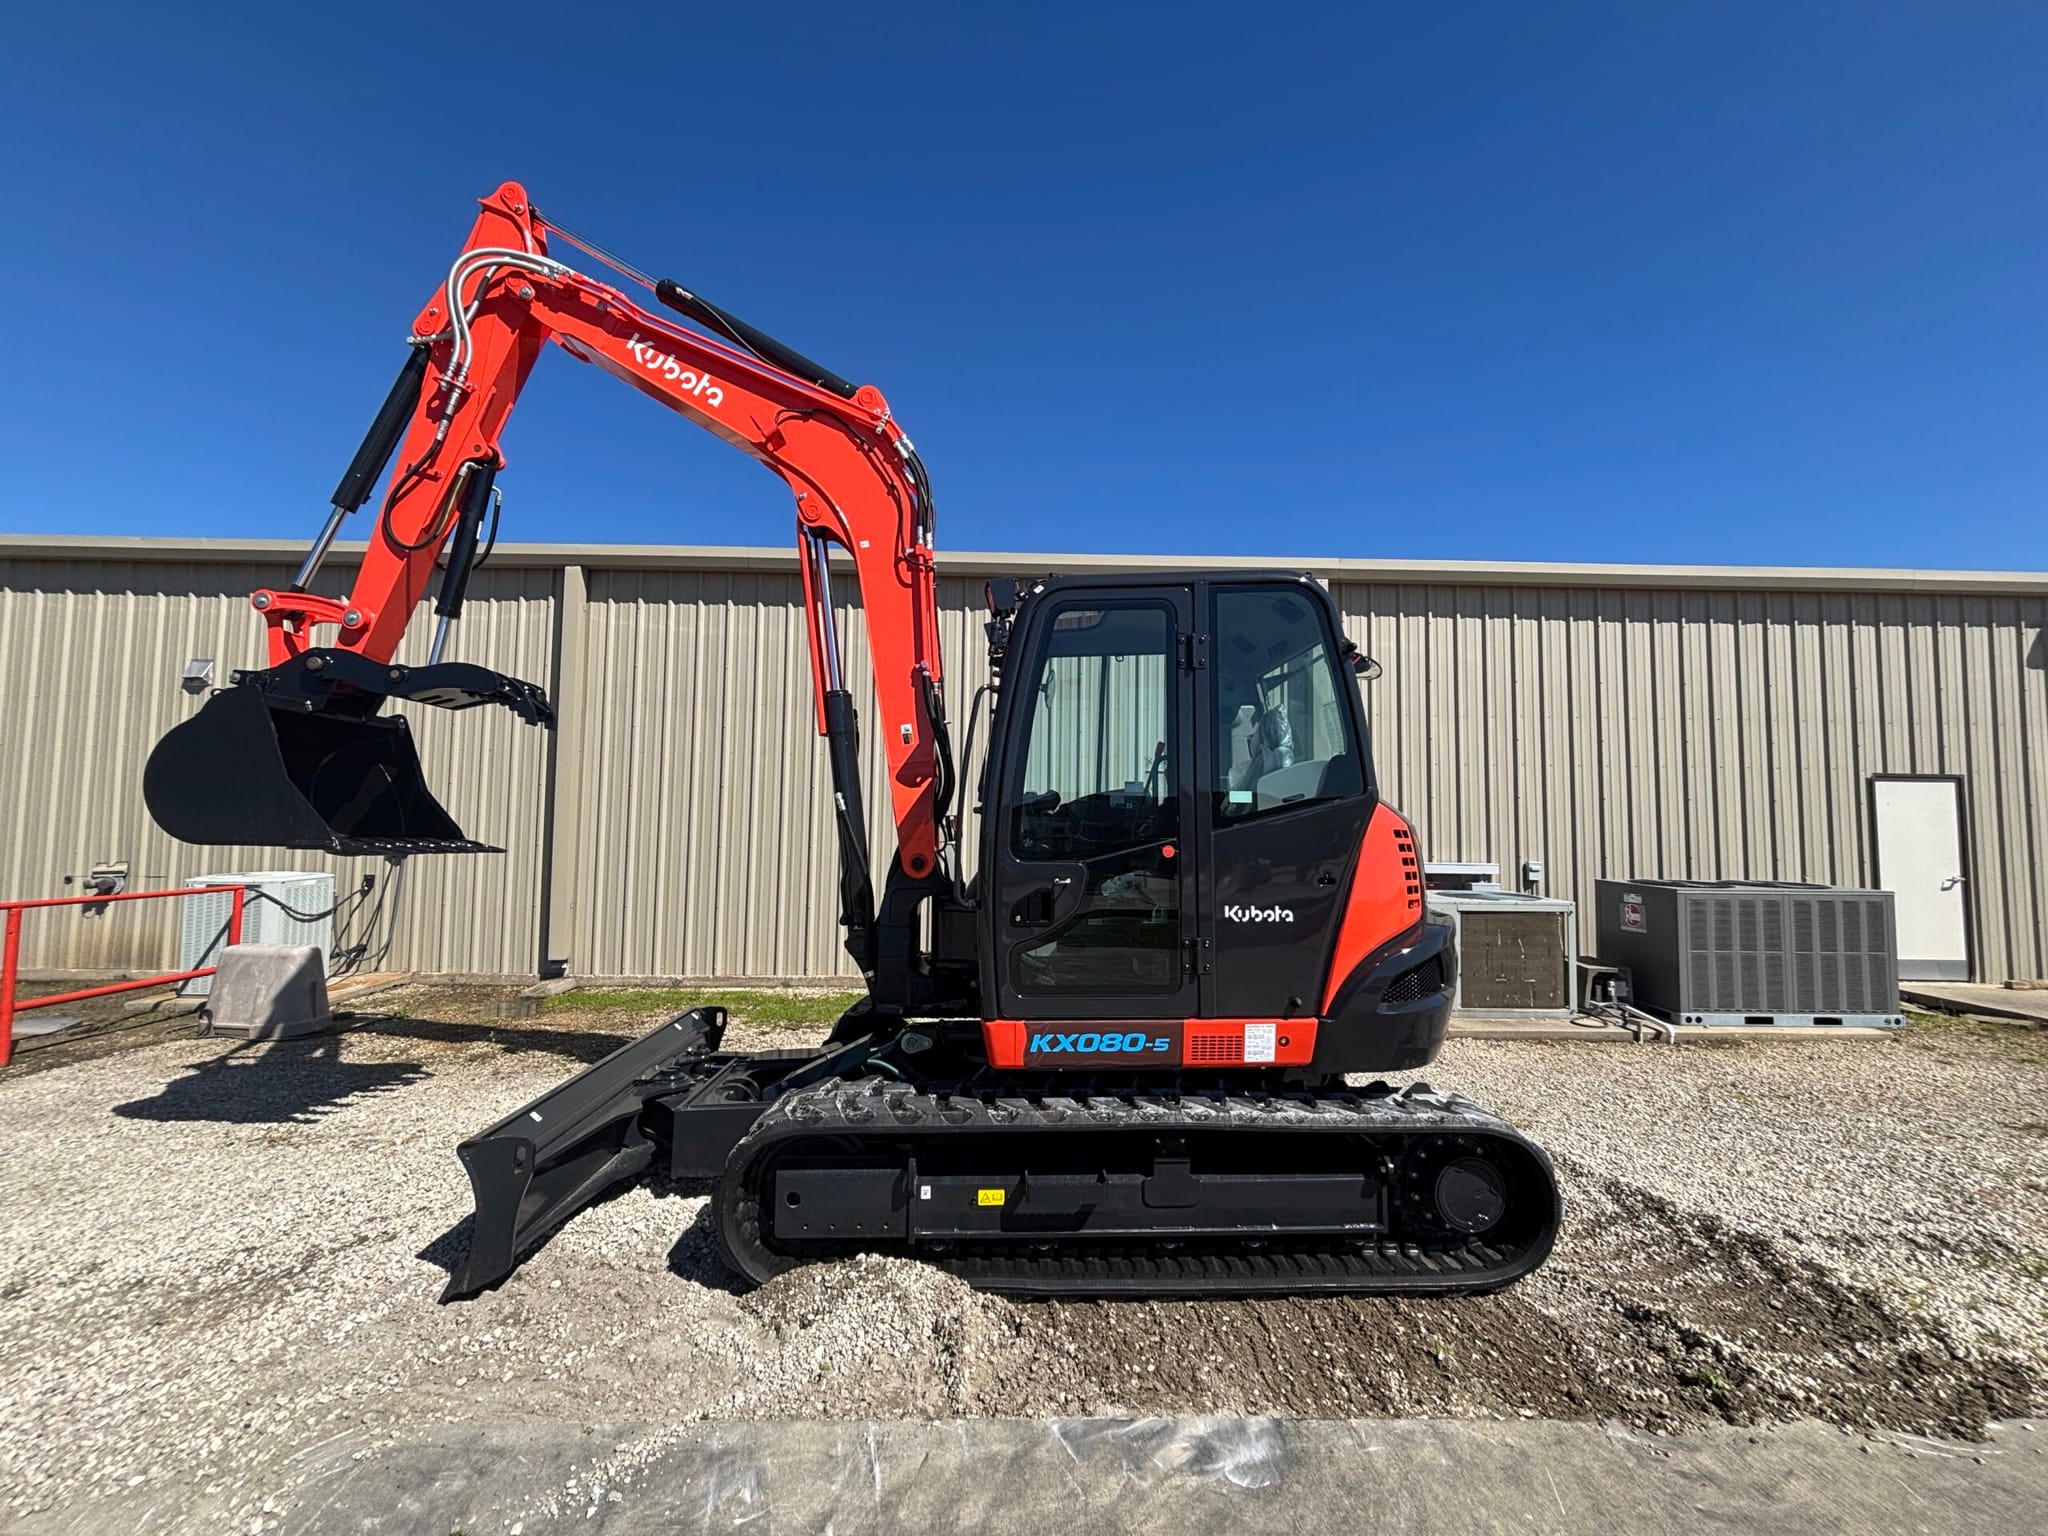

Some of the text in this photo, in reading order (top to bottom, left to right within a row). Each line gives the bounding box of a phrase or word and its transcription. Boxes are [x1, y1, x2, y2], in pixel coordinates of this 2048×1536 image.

[626, 332, 723, 408] Kubota
[1224, 905, 1294, 922] Kubota
[1029, 1033, 1170, 1053] KX080-5
